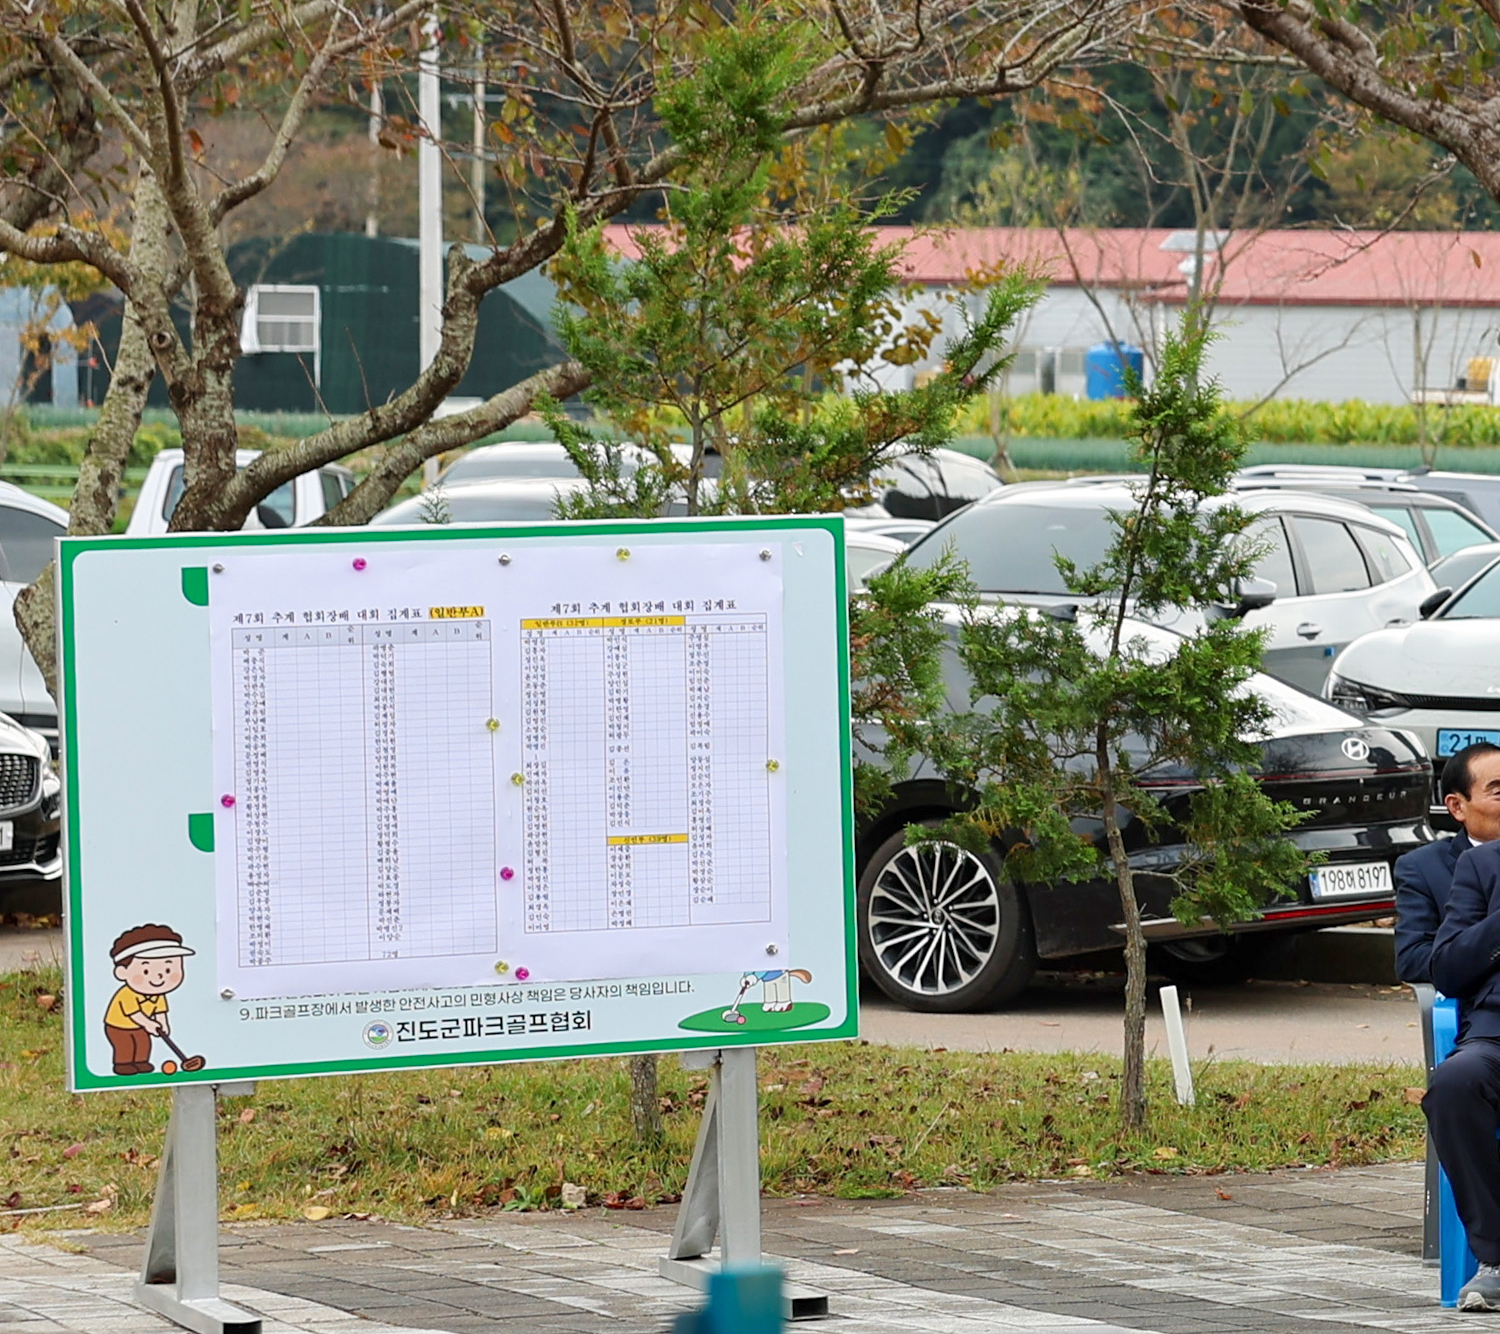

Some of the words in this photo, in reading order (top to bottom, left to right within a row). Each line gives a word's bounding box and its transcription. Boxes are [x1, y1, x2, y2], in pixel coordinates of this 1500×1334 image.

[233, 612, 264, 624] 제7회
[272, 611, 295, 623] 추계
[303, 609, 349, 623] 협회장배
[357, 608, 379, 620] 대회
[387, 607, 422, 619] 집계표
[551, 603, 581, 614] 제7회
[588, 602, 611, 613] 추계
[619, 601, 664, 613] 협회장배
[672, 600, 694, 611] 대회
[702, 599, 737, 611] 집계표
[1303, 790, 1408, 806] GRANDEUR
[1358, 866, 1388, 889] 8197
[239, 999, 352, 1022] 9.파크골프장에서
[355, 996, 396, 1015] 발생한
[398, 992, 467, 1012] 안전사고의
[469, 989, 524, 1008] 민형사상
[526, 985, 566, 1004] 책임은
[569, 984, 622, 1002] 당사자의
[625, 980, 695, 999] 책임입니다.
[396, 1009, 592, 1043] 진도군파크골프협회
